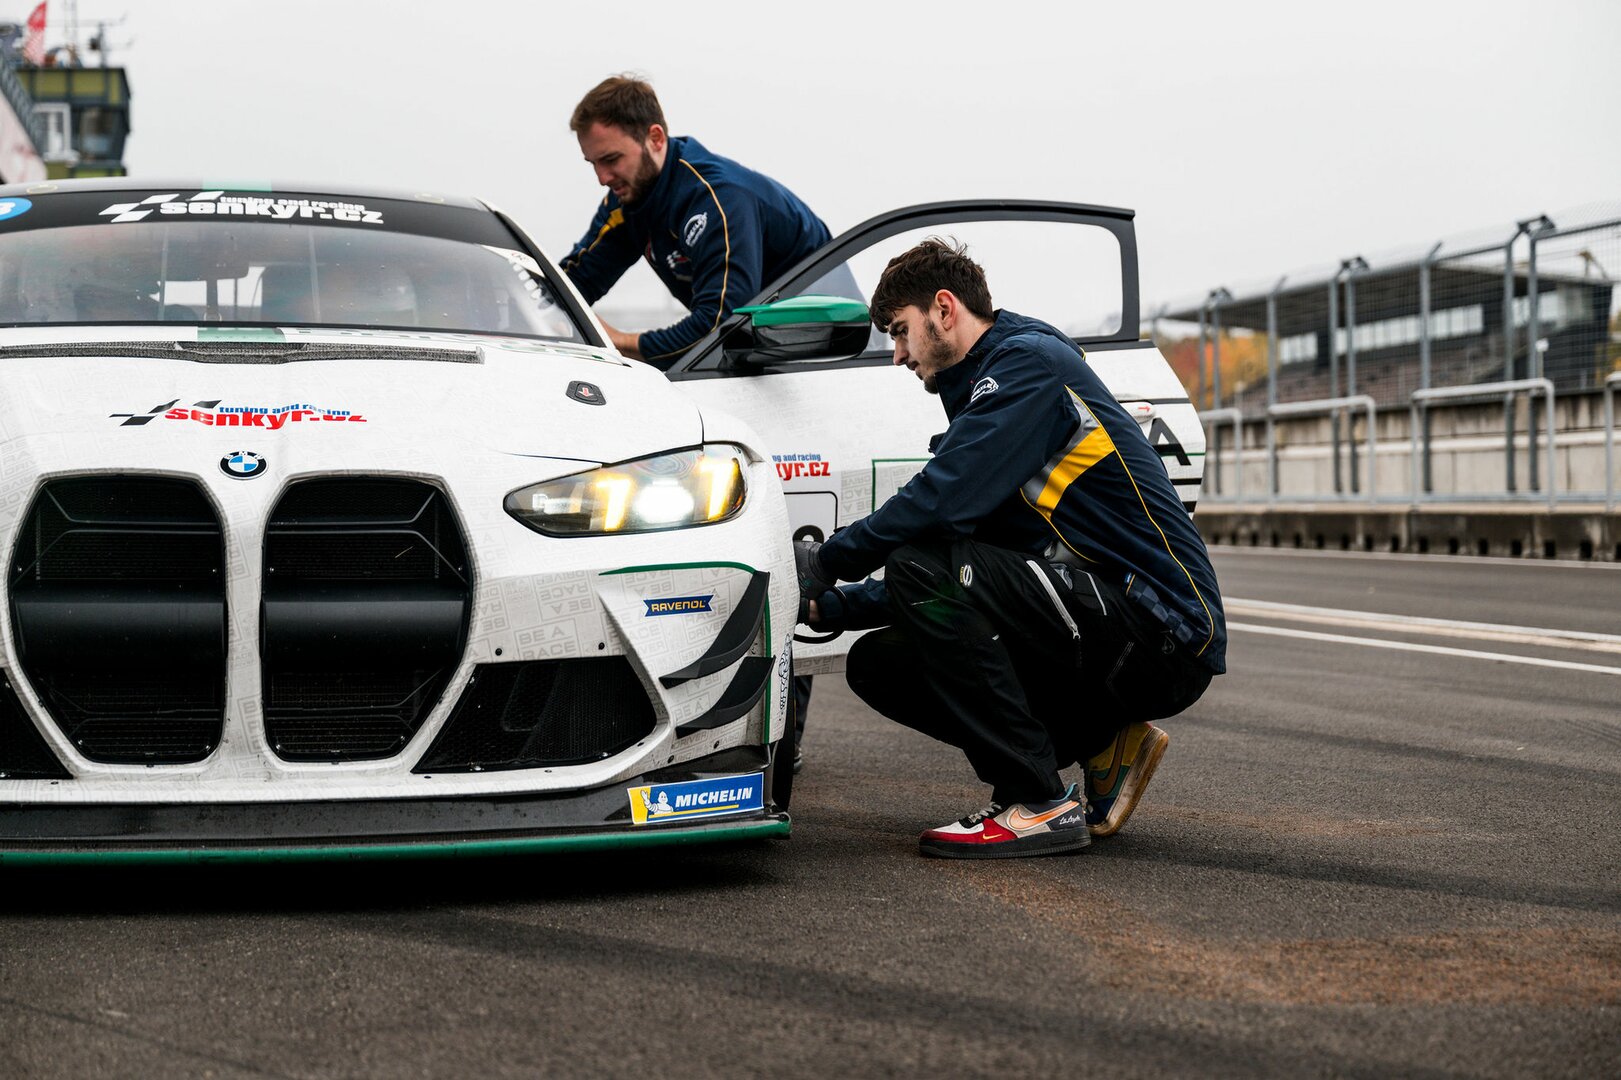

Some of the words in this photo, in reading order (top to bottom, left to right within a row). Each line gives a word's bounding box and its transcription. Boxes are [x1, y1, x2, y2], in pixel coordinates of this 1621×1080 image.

[220, 196, 275, 205] tuning
[277, 198, 310, 207] and
[159, 199, 384, 224] senkyr.cz
[218, 405, 269, 415] tuning
[271, 403, 300, 415] and
[164, 407, 368, 430] senkyr.cz
[783, 453, 797, 462] and
[797, 453, 821, 462] racing
[651, 600, 706, 612] RAVENOL
[675, 786, 753, 808] MICHELIN
